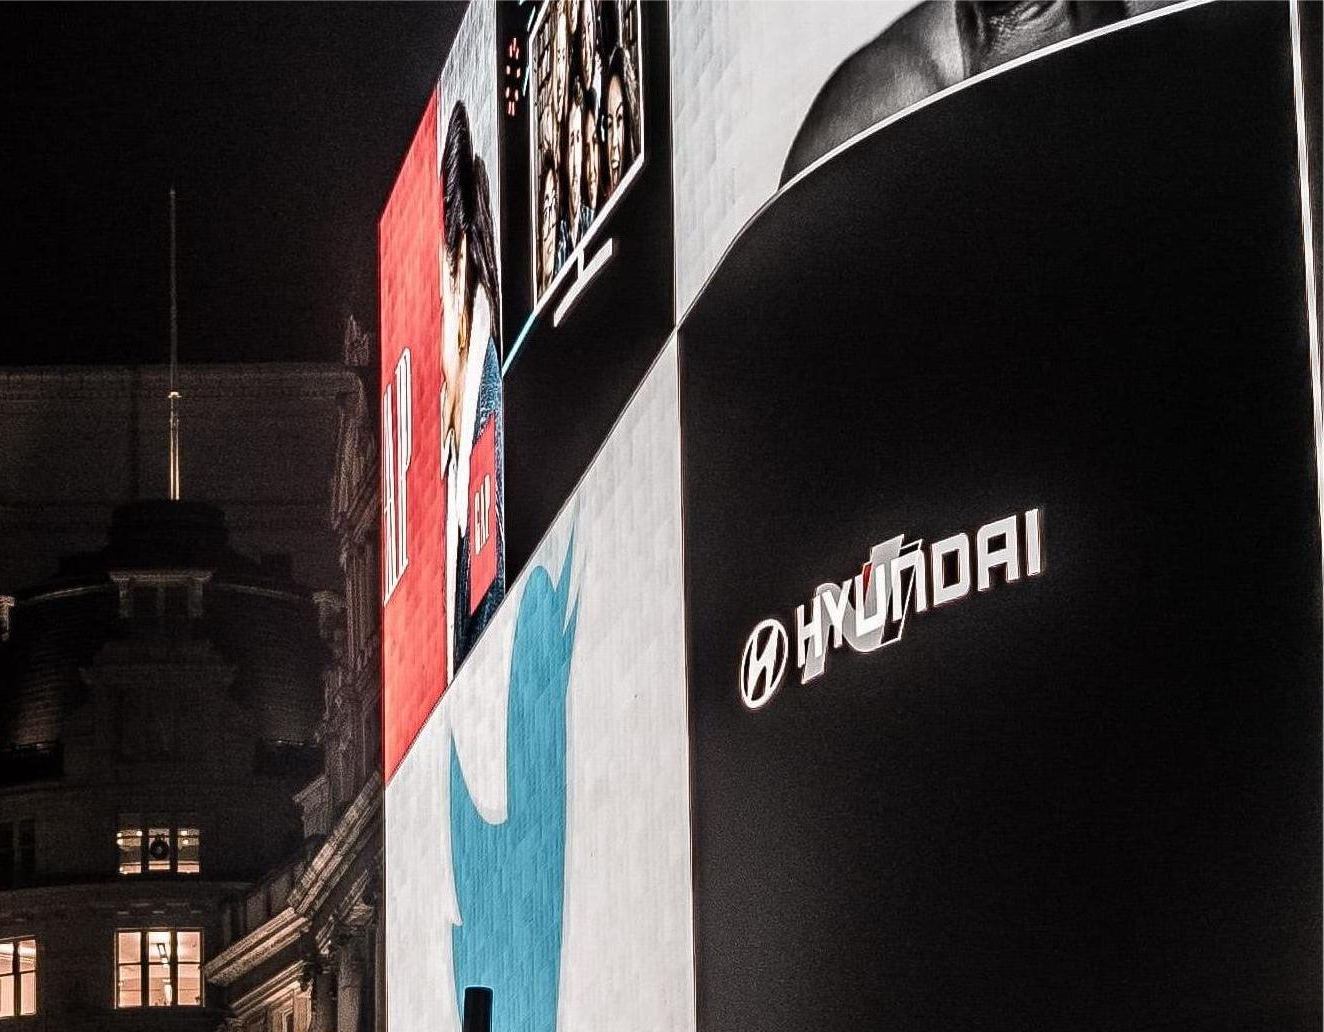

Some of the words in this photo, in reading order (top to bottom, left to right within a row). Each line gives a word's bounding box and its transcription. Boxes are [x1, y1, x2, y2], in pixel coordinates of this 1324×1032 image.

[383, 347, 412, 606] AP
[474, 474, 491, 555] GAP
[794, 508, 1042, 670] HYUNDAI
